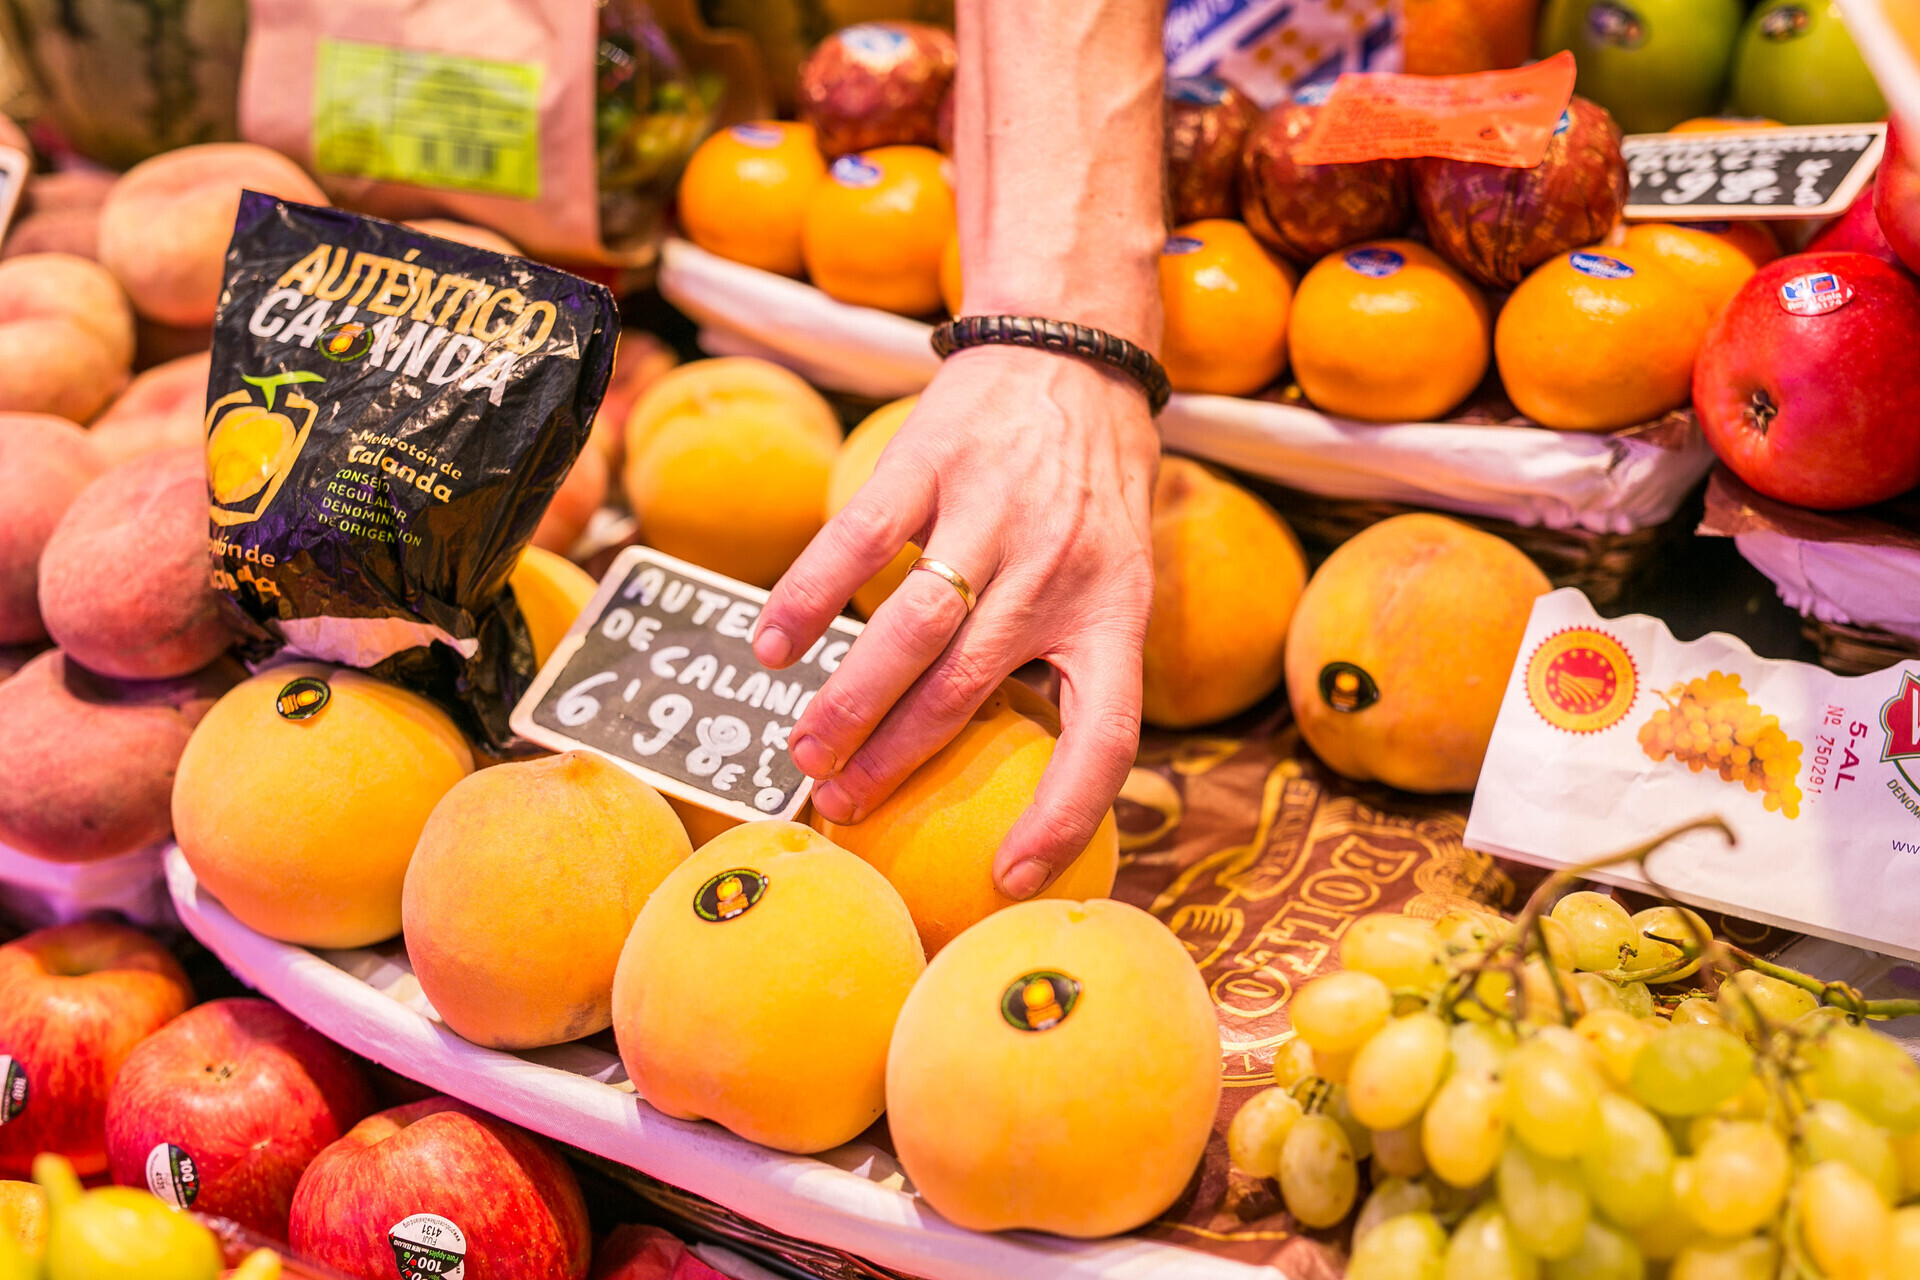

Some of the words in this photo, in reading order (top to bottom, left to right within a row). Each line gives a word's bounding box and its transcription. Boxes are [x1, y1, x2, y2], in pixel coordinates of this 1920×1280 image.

[277, 243, 558, 355] AUTÉNTICO
[358, 429, 438, 468] Melocotón
[440, 462, 462, 480] de
[335, 469, 390, 494] CONSEJO
[339, 519, 396, 544] ORIGEN
[244, 544, 276, 568] de
[623, 567, 850, 674] AUTEIC
[649, 645, 818, 721] CALAN
[1806, 734, 1836, 797] 750291
[1210, 834, 1418, 1018] BOLLO
[421, 1224, 443, 1238] 4131
[422, 1235, 438, 1247] FUJI
[428, 1249, 447, 1261] Apples
[446, 1252, 460, 1264] Pure
